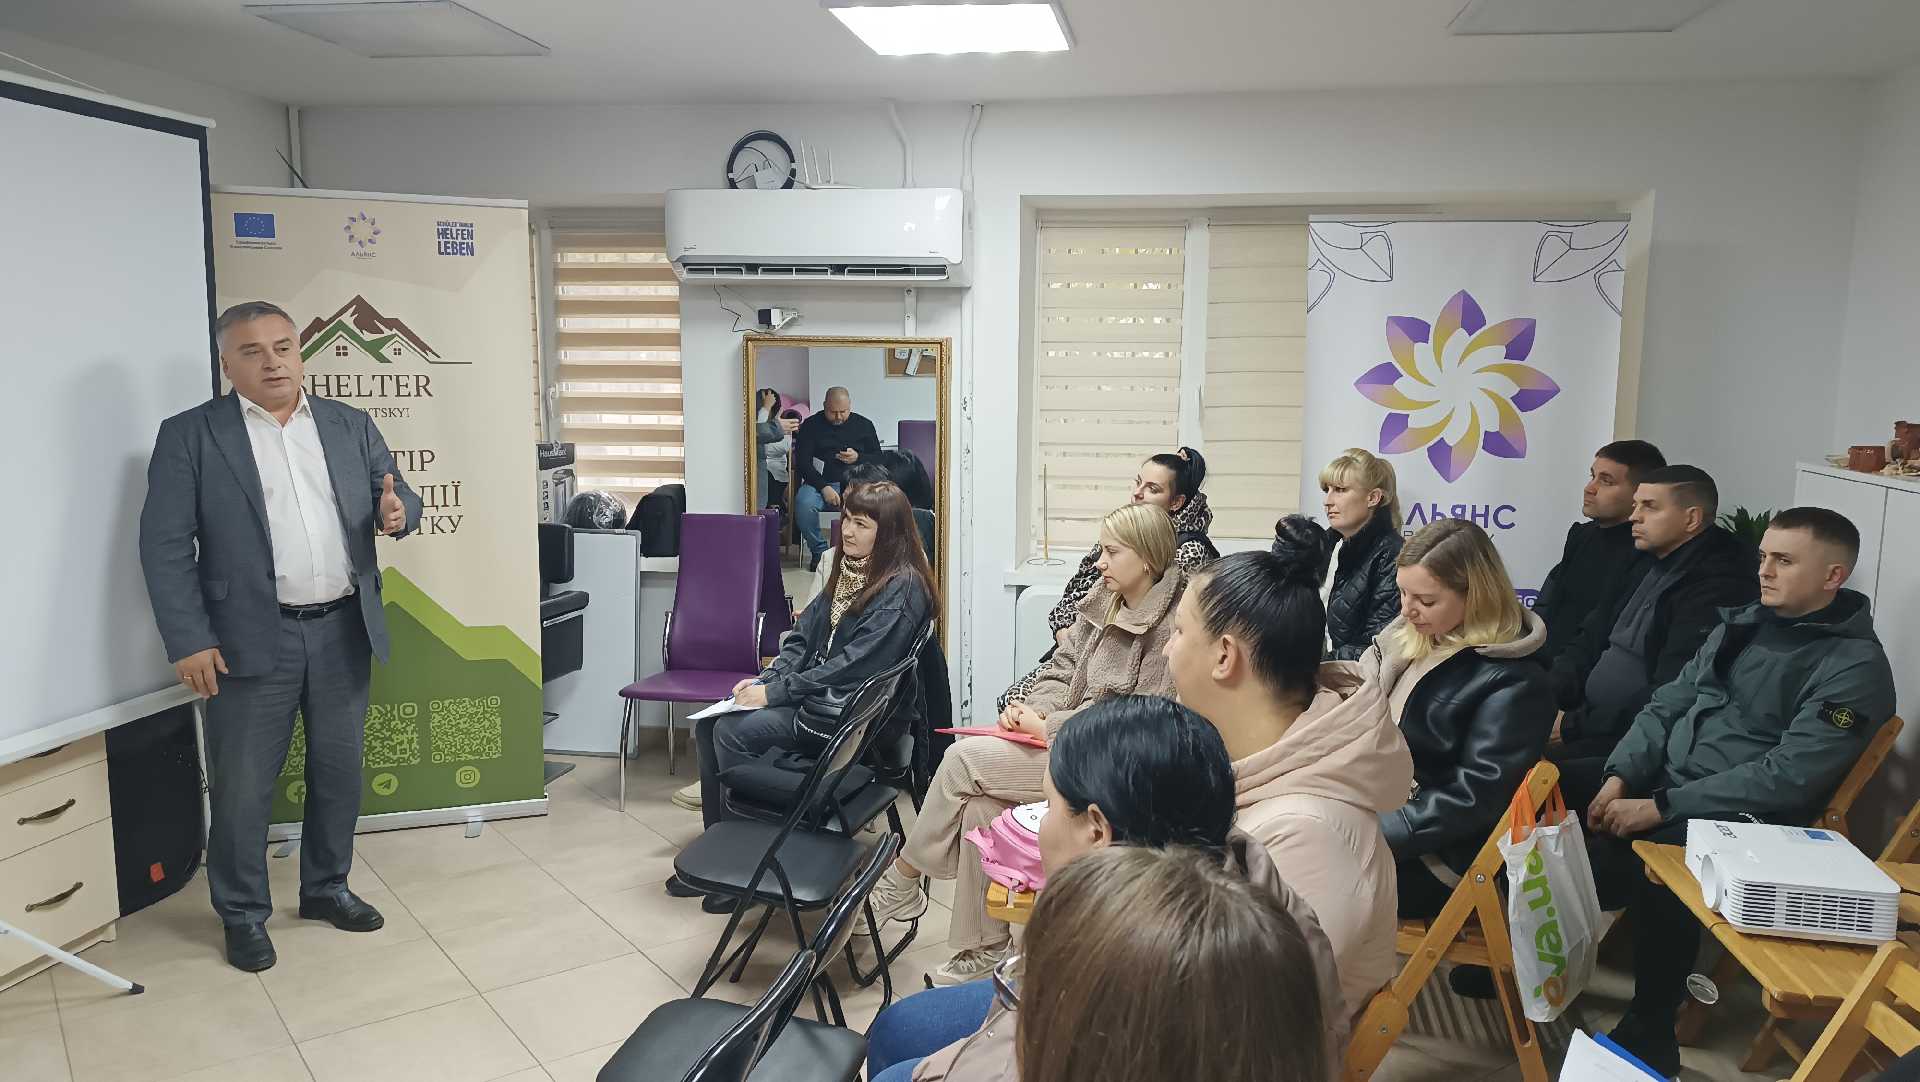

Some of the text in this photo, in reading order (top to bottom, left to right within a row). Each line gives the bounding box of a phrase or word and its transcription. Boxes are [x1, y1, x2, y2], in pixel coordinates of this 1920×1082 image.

[437, 228, 473, 240] HELFEN
[438, 241, 474, 256] LEBEN
[389, 449, 435, 471] ТІР
[419, 481, 462, 512] ДІЇ
[1405, 502, 1517, 529] ЛЬЯНС
